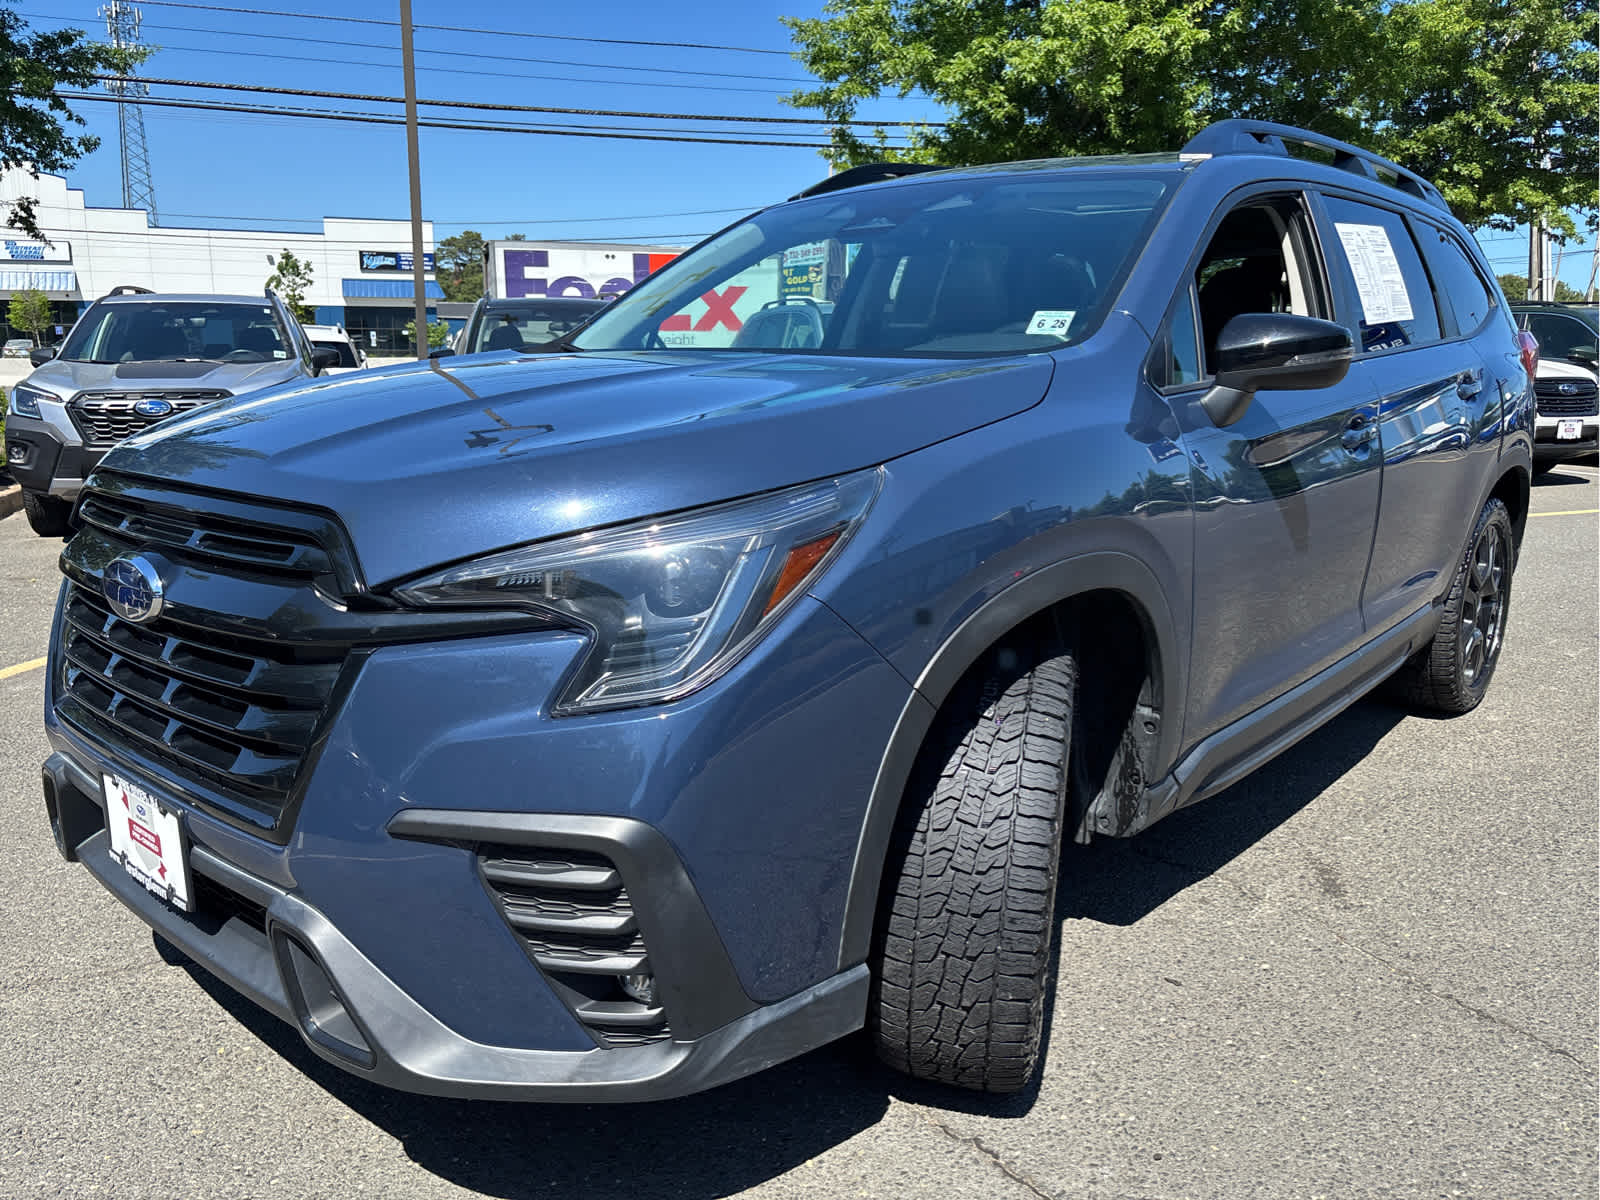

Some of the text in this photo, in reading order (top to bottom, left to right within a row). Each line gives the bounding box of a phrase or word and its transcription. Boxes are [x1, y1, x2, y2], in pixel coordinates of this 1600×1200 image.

[786, 275, 808, 285] GOLD
[1037, 319, 1067, 329] 6 28
